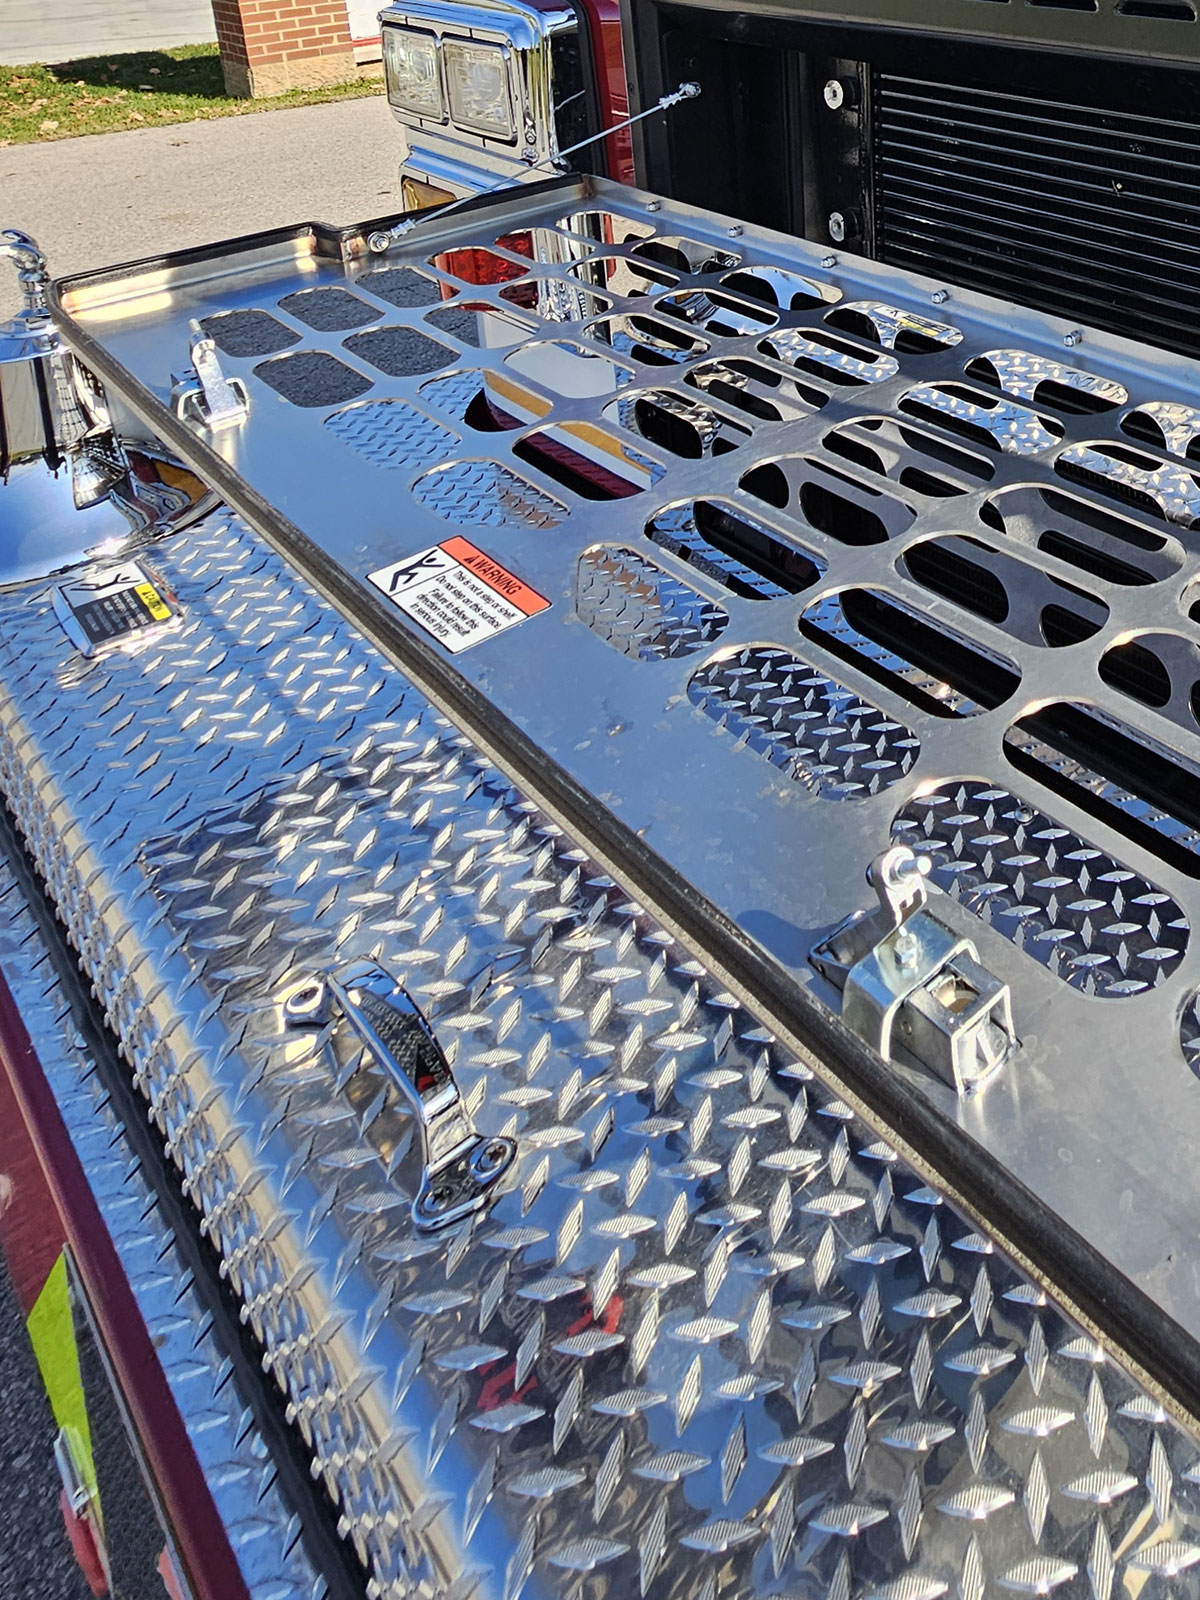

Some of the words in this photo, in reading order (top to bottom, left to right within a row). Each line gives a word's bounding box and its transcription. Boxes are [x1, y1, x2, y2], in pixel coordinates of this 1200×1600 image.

[435, 575, 447, 584] Do
[445, 582, 457, 591] not
[451, 589, 466, 600] step
[469, 603, 483, 613] this
[454, 570, 467, 582] This
[470, 584, 481, 593] not
[480, 594, 495, 604] step
[473, 559, 522, 595] WARNING
[415, 607, 436, 624] serious
[416, 594, 441, 612] direction
[436, 611, 457, 624] could
[451, 622, 470, 636] result
[428, 588, 449, 605] Failure
[451, 606, 469, 621] follow
[465, 619, 479, 629] this
